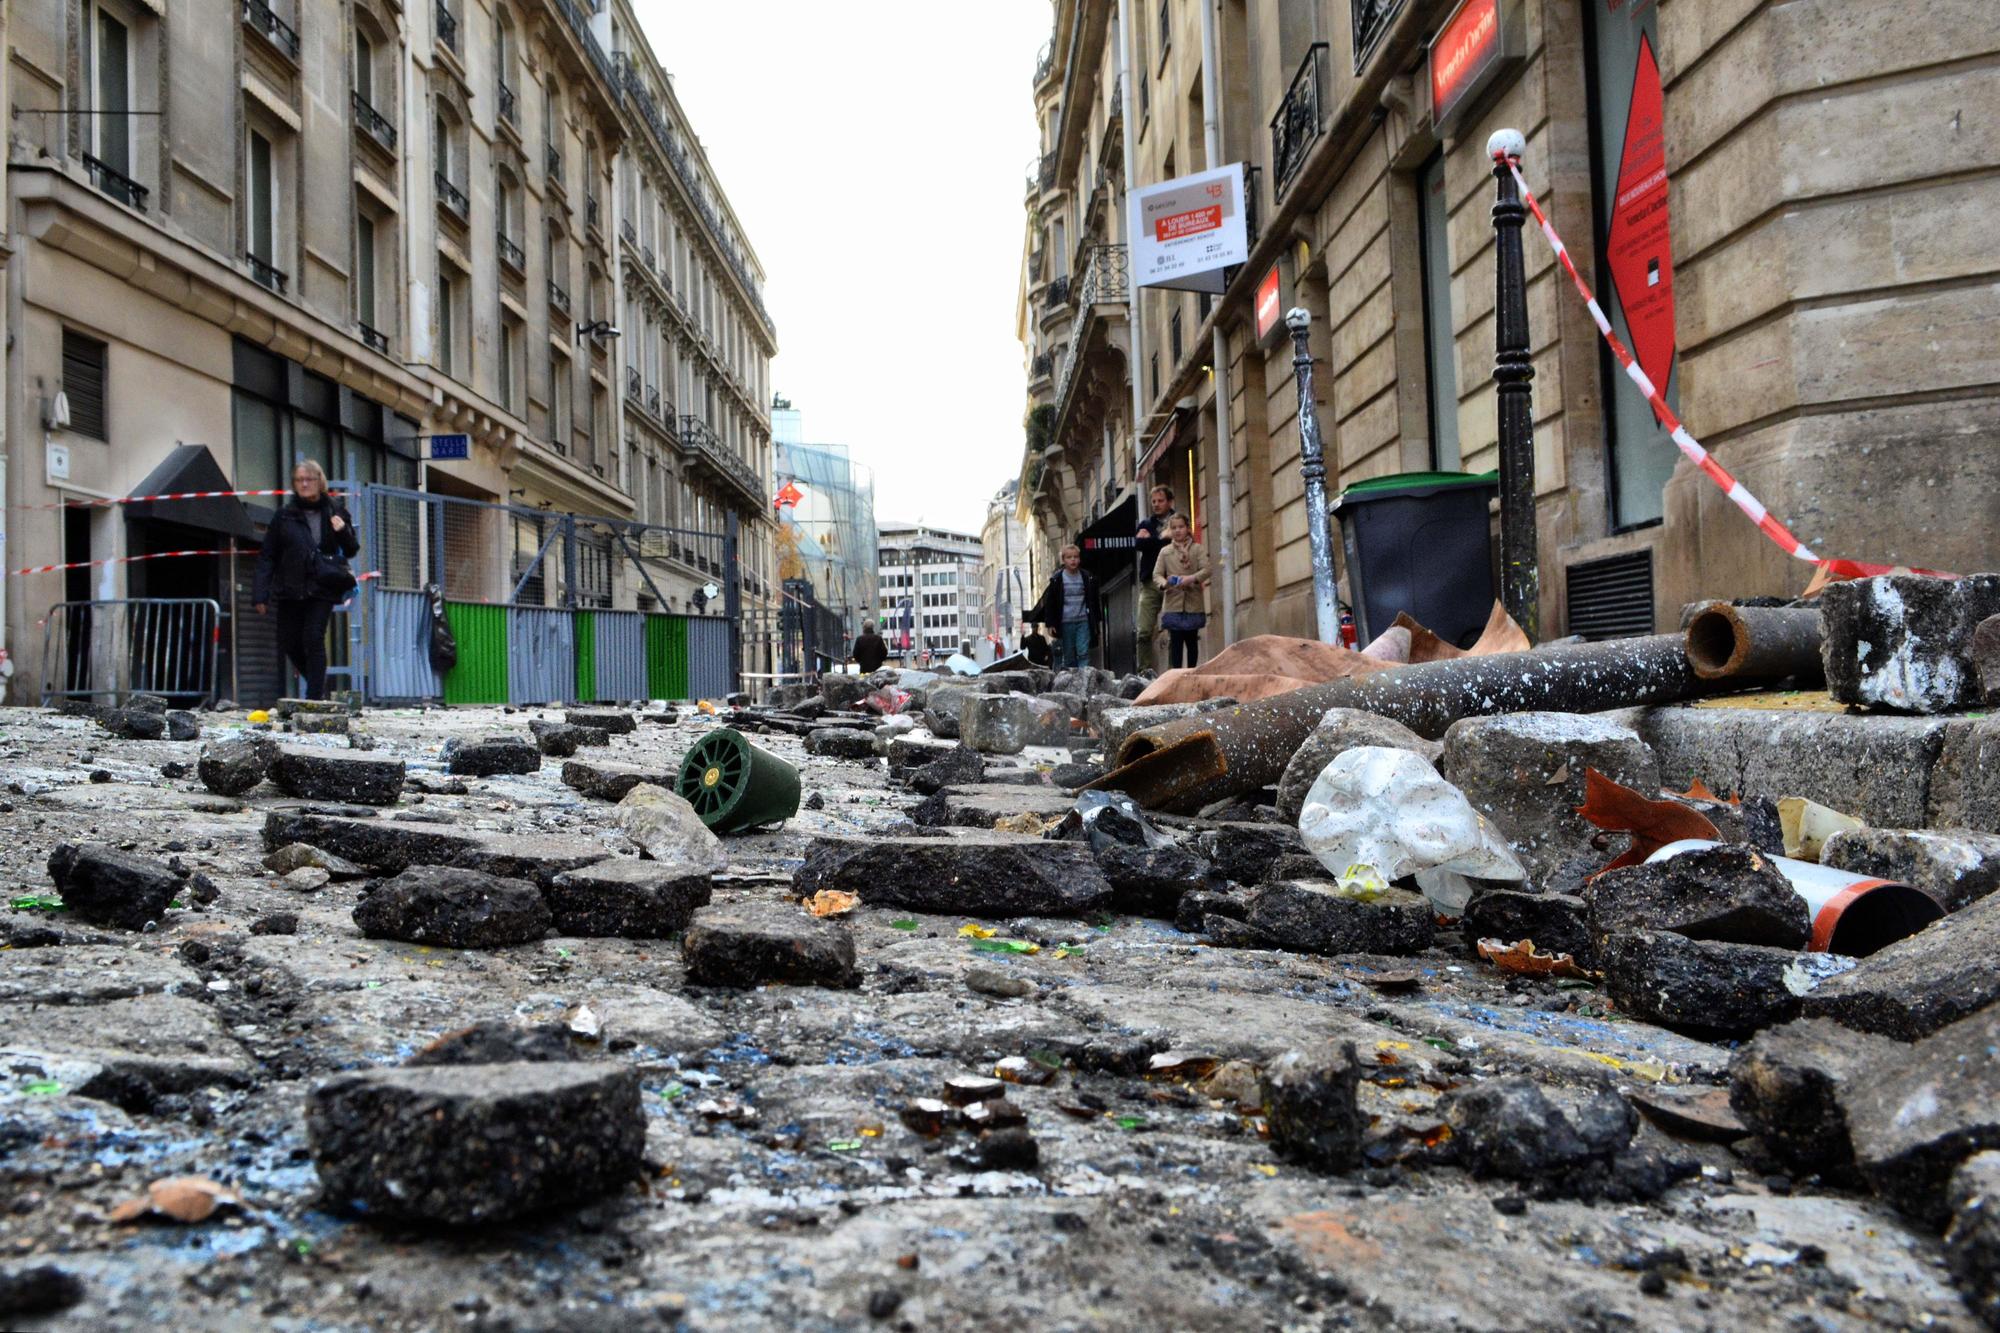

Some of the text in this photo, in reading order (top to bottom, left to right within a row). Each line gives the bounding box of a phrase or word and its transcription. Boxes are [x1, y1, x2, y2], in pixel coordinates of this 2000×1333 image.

[1167, 214, 1190, 224] LOUER
[432, 438, 465, 447] STELLA
[432, 447, 465, 456] MARIS
